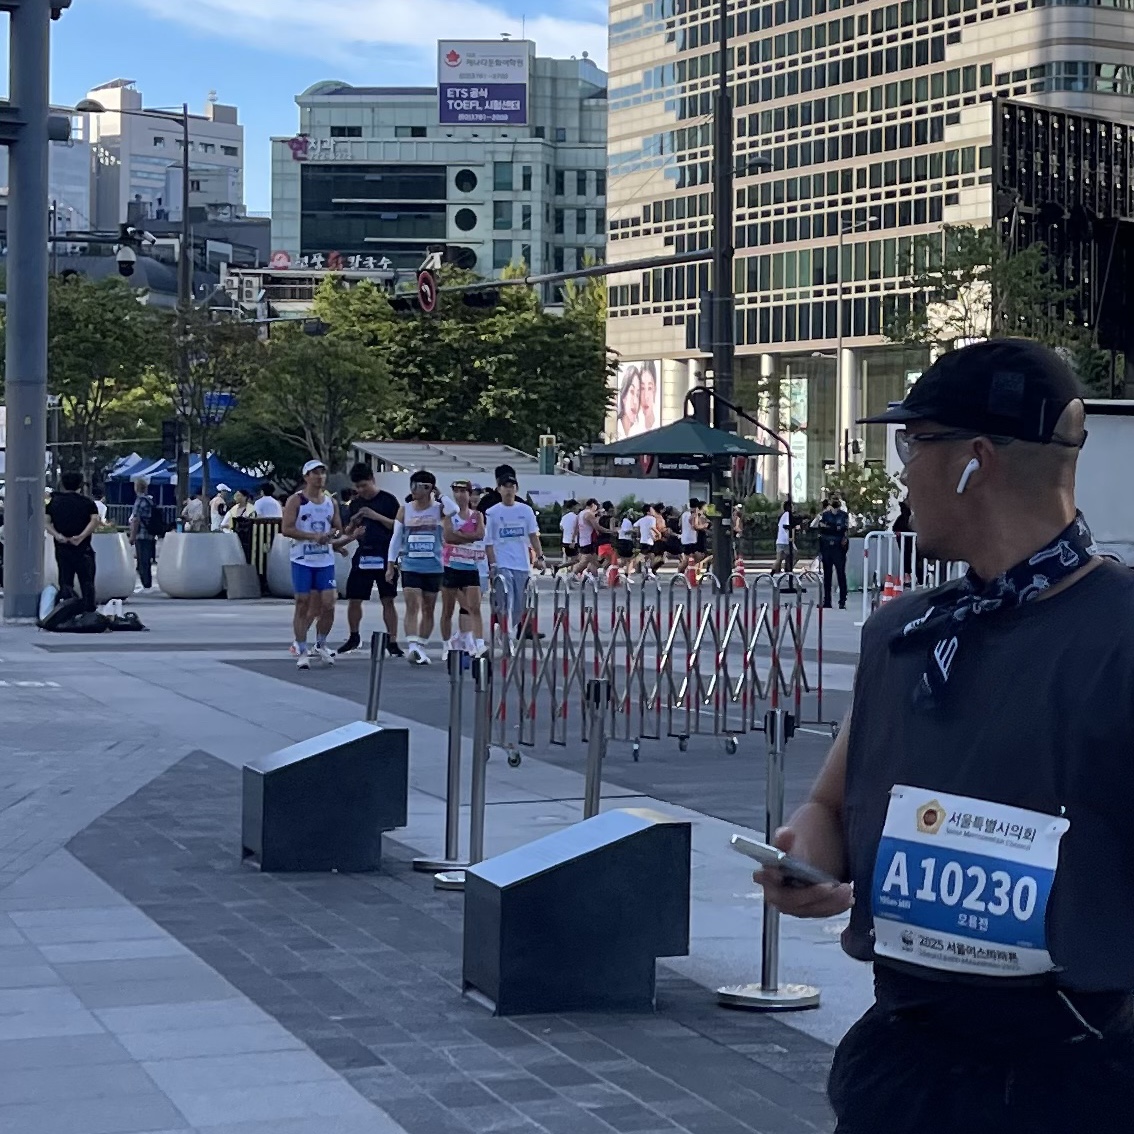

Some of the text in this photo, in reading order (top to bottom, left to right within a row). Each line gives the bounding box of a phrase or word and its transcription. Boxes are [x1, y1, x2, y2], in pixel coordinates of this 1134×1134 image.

[446, 87, 468, 98] ETS
[949, 811, 1037, 843] 서울특별시의회
[918, 935, 944, 951] 2025
